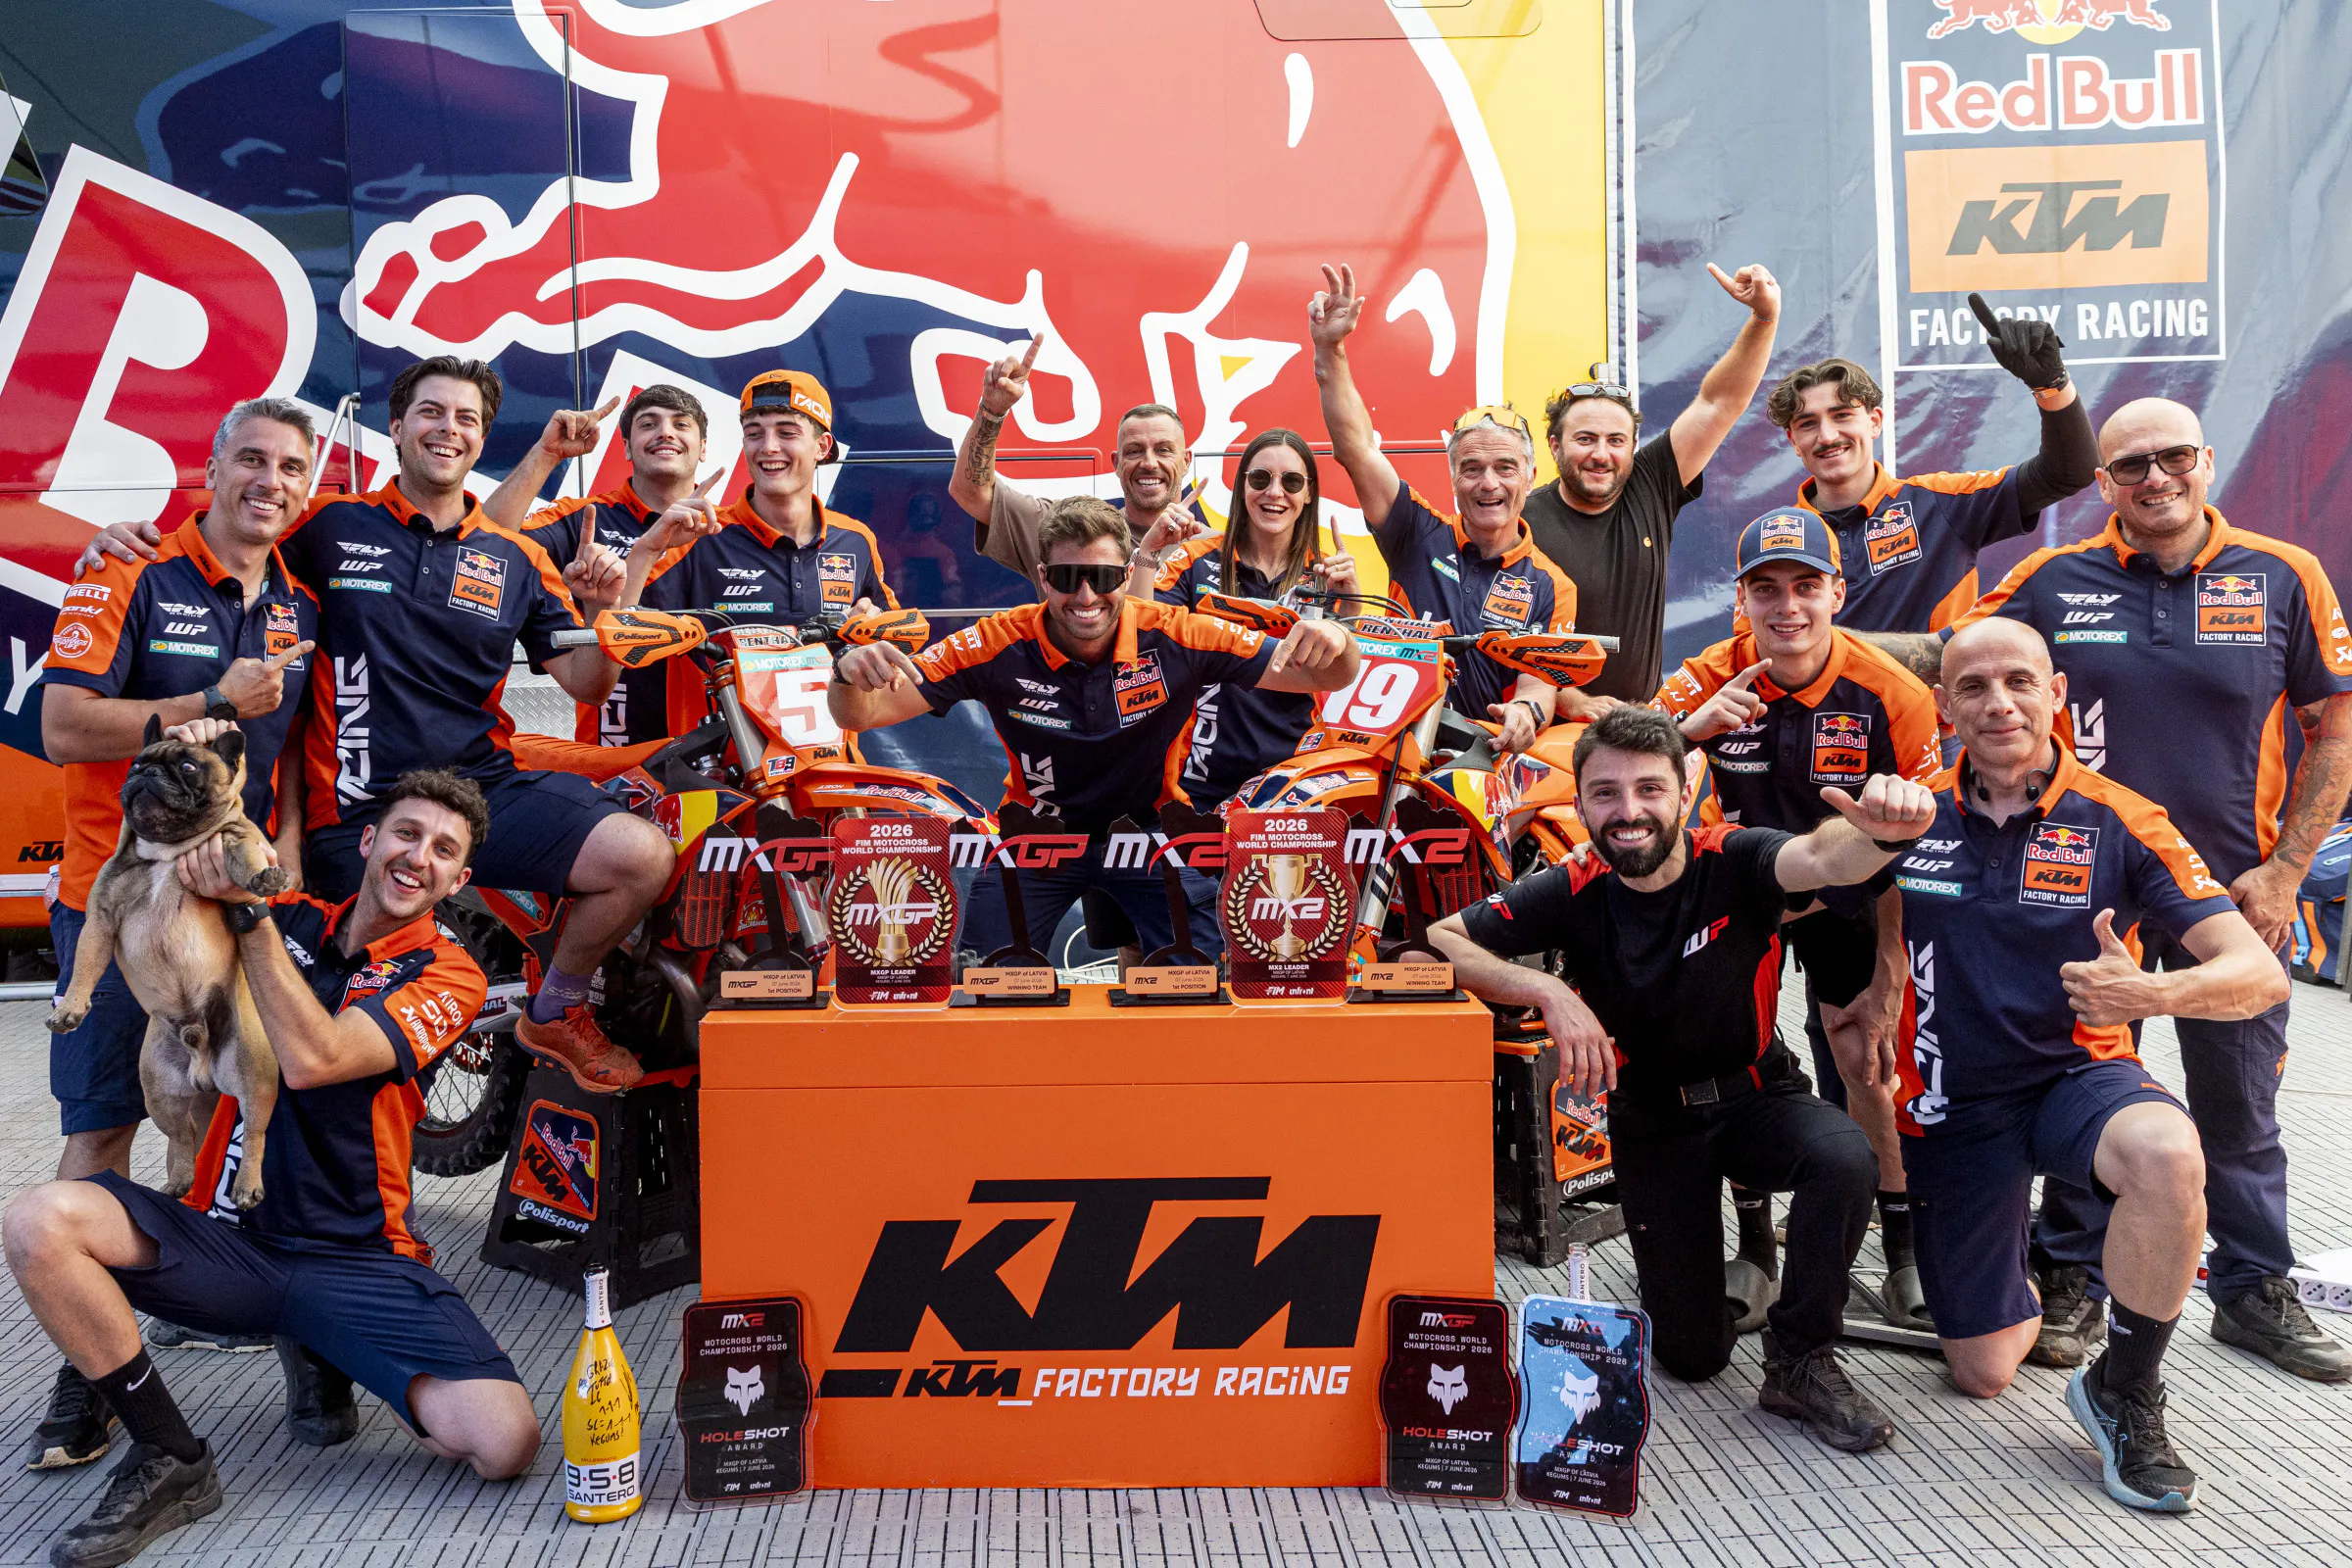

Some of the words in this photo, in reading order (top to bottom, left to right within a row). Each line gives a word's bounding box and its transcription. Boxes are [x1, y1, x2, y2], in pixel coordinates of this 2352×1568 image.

[1906, 57, 2048, 132] Red
[2060, 52, 2199, 127] Bull
[1945, 180, 2170, 256] KTM
[1910, 305, 2061, 347] FACY
[2077, 299, 2209, 341] RACING
[1762, 526, 1782, 537] Red
[1782, 525, 1803, 537] Bull
[1867, 524, 1888, 540] Red
[1888, 516, 1912, 535] Bull
[1771, 536, 1793, 546] KTM
[1878, 536, 1910, 557] KTM
[338, 561, 383, 571] WP
[1873, 557, 1898, 571] FACTORY
[1898, 549, 1920, 561] RACING
[458, 562, 480, 578] Red
[481, 568, 503, 587] Bull
[819, 568, 837, 580] Red
[838, 568, 855, 581] Bull
[342, 579, 388, 591] MOTOREX
[462, 584, 494, 601] KTM
[722, 585, 762, 596] WP
[828, 586, 851, 598] KTM
[1492, 584, 1511, 599] Red
[1510, 588, 1534, 602] Bull
[452, 597, 477, 611] FACTORY
[477, 604, 498, 616] RACING
[2199, 592, 2230, 606] Red
[2231, 592, 2263, 606] Bull
[727, 603, 771, 612] MOTOREX
[1492, 602, 1522, 614] KTM
[1483, 610, 1504, 623] FACTORY
[2062, 612, 2115, 624] WP
[2208, 612, 2255, 625] KTM
[164, 622, 208, 635] WP
[1361, 623, 1434, 639] RENTHAL
[2069, 631, 2124, 642] MOTOREX
[612, 632, 662, 642] Polisport
[2199, 633, 2232, 642] FACTORY
[169, 643, 217, 656] MOTOREX
[1355, 642, 1397, 658] TOREX
[1398, 647, 1436, 662] MX2
[756, 655, 805, 670] MOTOREX
[1534, 655, 1589, 670] Polisport
[1115, 673, 1138, 691] Red
[1138, 667, 1160, 685] Bull
[1127, 690, 1159, 709] KTM
[1322, 659, 1419, 729] 19
[775, 668, 843, 746] 5
[1019, 698, 1058, 710] WP
[1022, 713, 1069, 729] MOTOREX
[1122, 711, 1148, 723] FACTORY
[1183, 683, 1221, 783] RACIN
[1338, 732, 1370, 746] KTM
[1816, 732, 1843, 746] Red
[1843, 733, 1868, 748] Bull
[813, 747, 838, 760] KTM
[1719, 742, 1761, 755] WP
[1720, 760, 1769, 771] MOTOREX
[1822, 754, 1861, 767] KTM
[1813, 772, 1841, 782] FACTORY
[863, 785, 890, 797] Red
[889, 787, 925, 803] Bull
[870, 824, 913, 837] 2026
[1265, 818, 1308, 832] 2026
[873, 838, 928, 847] MOTOCROSS
[1270, 840, 1337, 849] CHAMPIONSHIP
[1344, 828, 1470, 864] MX2
[950, 833, 1090, 877] MXGP
[1103, 833, 1229, 877] MX2
[2028, 844, 2060, 860] Red
[2060, 849, 2092, 863] Bull
[1903, 857, 1954, 871] WP
[1905, 876, 1958, 895] MOTOREX
[2034, 869, 2082, 887] KTM
[505, 889, 536, 913] TOREX
[2024, 891, 2057, 903] FACTORY
[2060, 894, 2086, 905] RACING
[846, 903, 939, 927] MXGP
[1251, 898, 1324, 922] MX2
[1683, 915, 1729, 958] WP
[1566, 1098, 1584, 1122] Red
[1584, 1107, 1601, 1127] Bull
[541, 1123, 558, 1150] Red
[557, 1143, 575, 1171] Bull
[1556, 1122, 1606, 1162] KTM
[523, 1143, 569, 1202] KTM
[1564, 1169, 1615, 1196] Polisp
[520, 1199, 589, 1235] Polisport
[832, 1176, 1382, 1352] KTM
[721, 1312, 765, 1329] MX2
[1420, 1312, 1476, 1328] MXGP
[705, 1336, 752, 1347] MOTOCROSS
[757, 1335, 782, 1344] WORLD
[1403, 1342, 1466, 1352] CHAMPIONSHIP
[1408, 1333, 1456, 1343] MOTOCROSS
[1460, 1336, 1488, 1345] WORLD
[1544, 1338, 1591, 1351] MOTOCROSS
[1595, 1345, 1623, 1355] WORLD
[700, 1346, 761, 1356] CHAMPIONSHIP
[766, 1343, 788, 1351] 2026
[1539, 1347, 1600, 1361] CHAMPIONSHIP
[1605, 1356, 1627, 1366] 2026
[903, 1360, 1022, 1397] KTM
[1034, 1367, 1200, 1397] FACTORY
[700, 1427, 790, 1444] HOLESHOT
[1403, 1427, 1493, 1442] HOLESHOT
[727, 1443, 763, 1452] AWARD
[1430, 1442, 1466, 1451] AWARD
[1533, 1434, 1624, 1455] HOLESHOT
[568, 1485, 635, 1504] SANTERO
